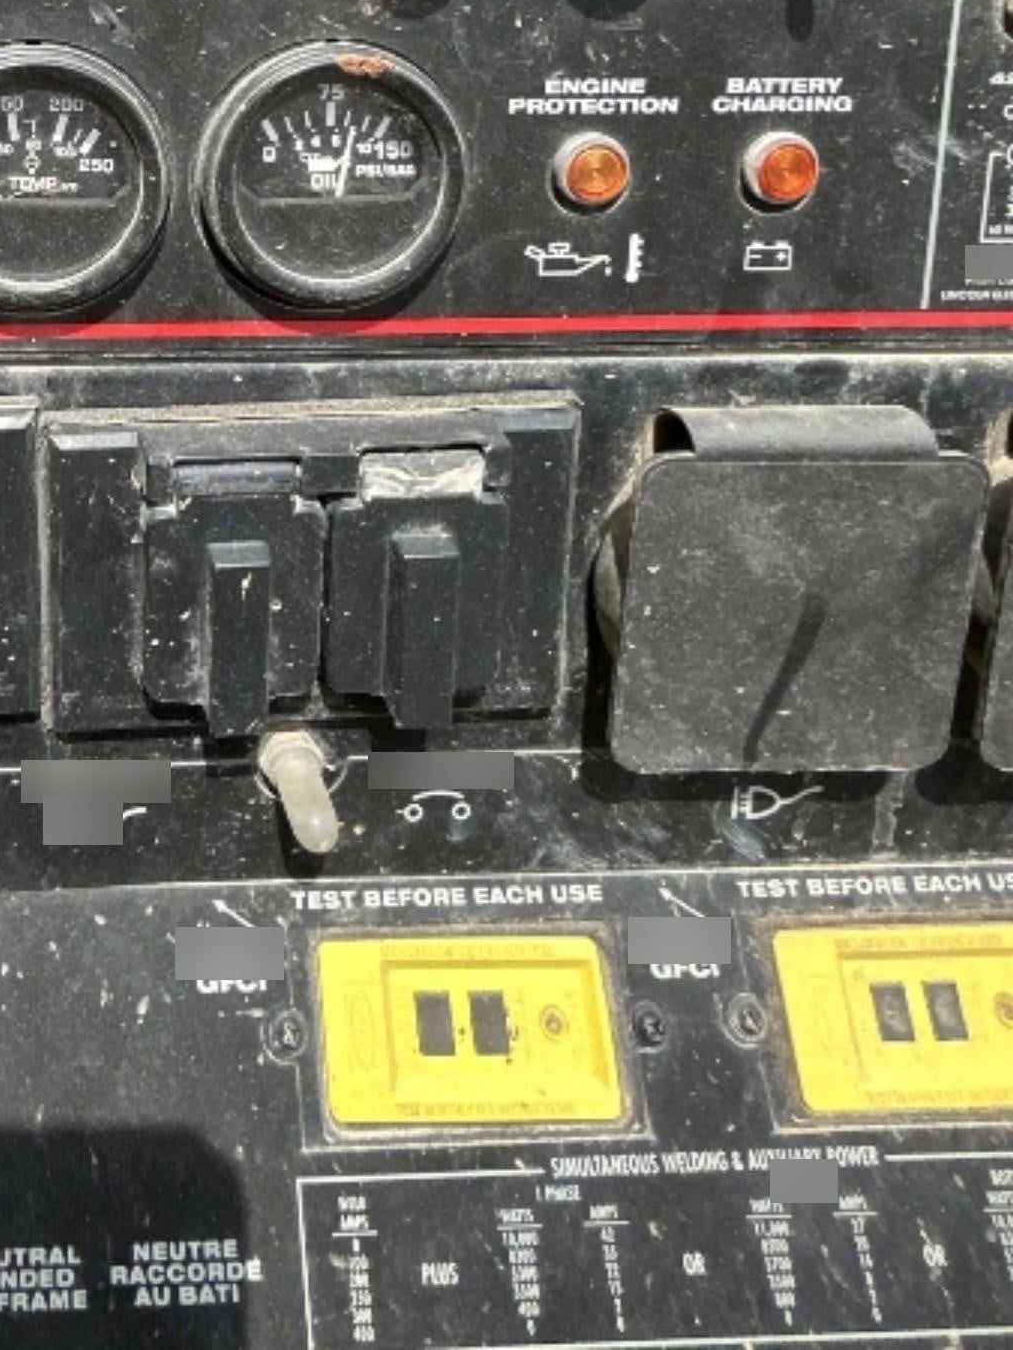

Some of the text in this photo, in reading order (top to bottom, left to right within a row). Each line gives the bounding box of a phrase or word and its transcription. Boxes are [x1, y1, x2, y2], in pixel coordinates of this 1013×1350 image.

[544, 78, 646, 94] ENGINE
[726, 77, 843, 95] BATTERY
[49, 97, 84, 112] 200
[508, 97, 679, 115] PROTECTION
[712, 96, 853, 113] CHARGING
[79, 158, 114, 172] 250
[8, 176, 58, 192] TEMP
[737, 877, 800, 898] TEST
[806, 875, 907, 896] BEFORE
[914, 874, 981, 893] EACH
[290, 884, 603, 910] TEST BEFORE EACH USE
[661, 1151, 729, 1174] WELDING
[133, 1239, 239, 1262] NEUTRE
[134, 1284, 171, 1307] AU
